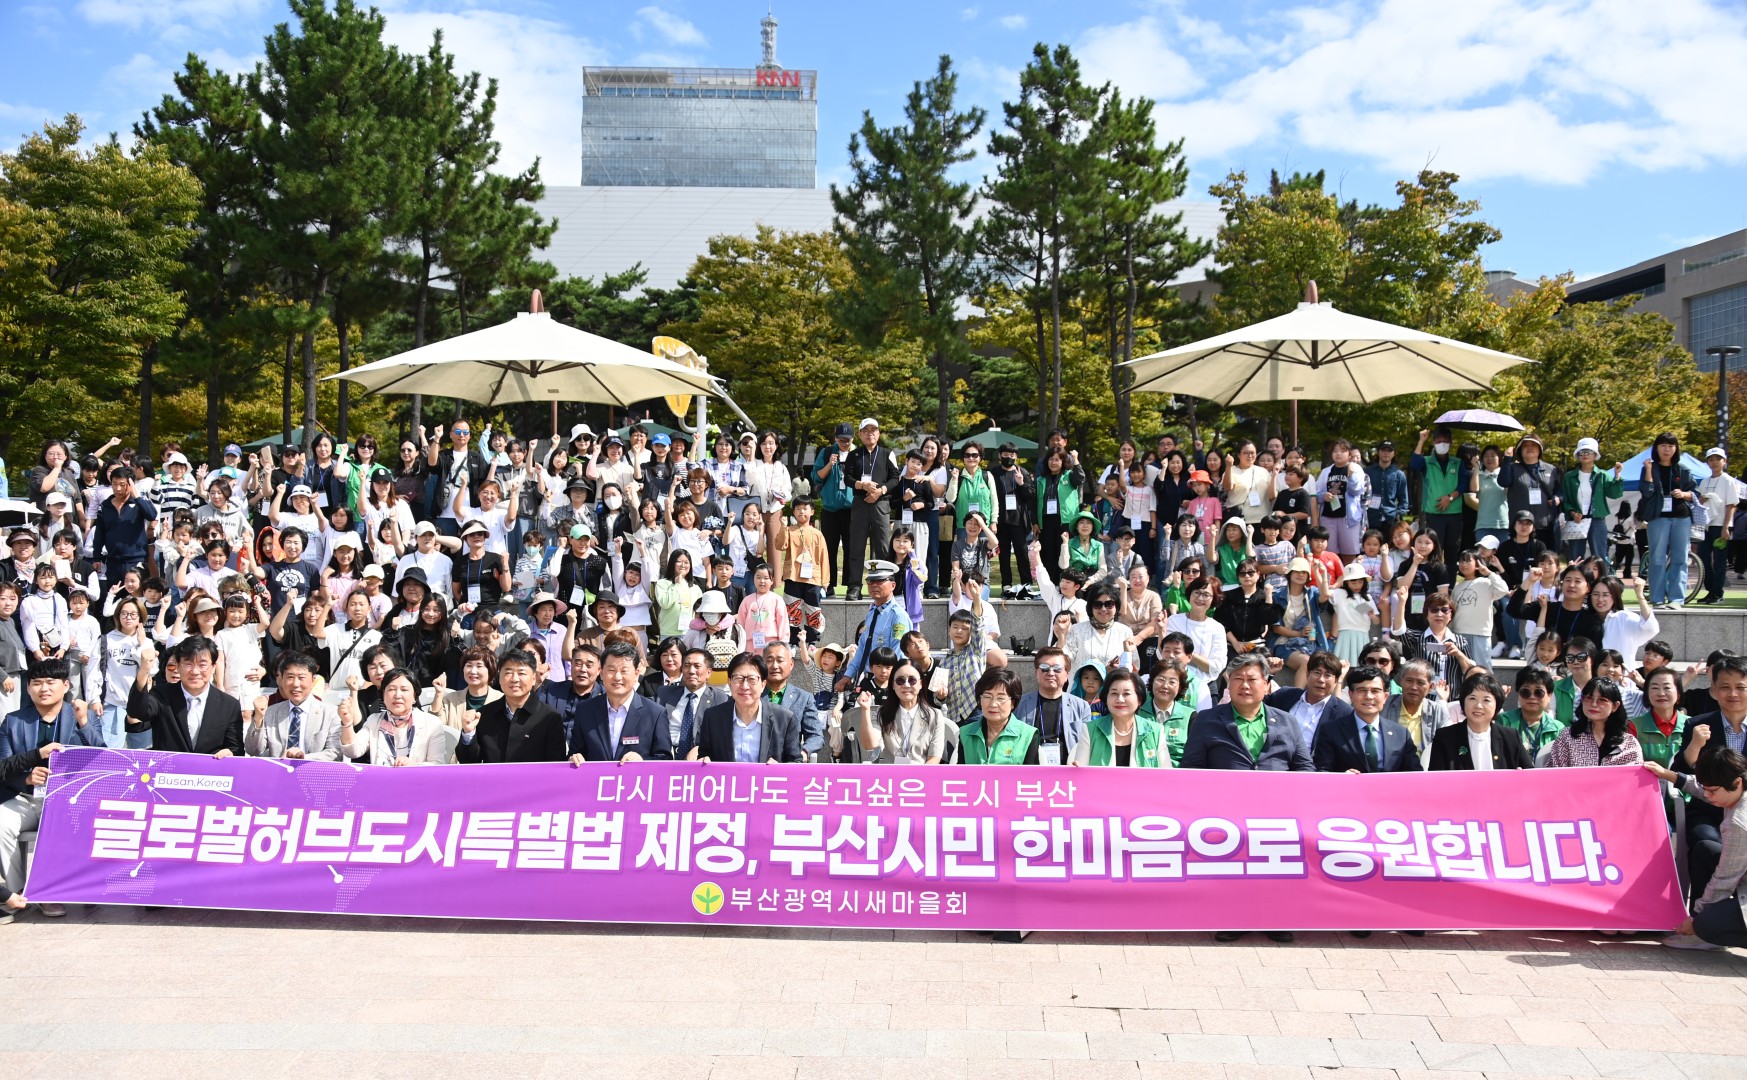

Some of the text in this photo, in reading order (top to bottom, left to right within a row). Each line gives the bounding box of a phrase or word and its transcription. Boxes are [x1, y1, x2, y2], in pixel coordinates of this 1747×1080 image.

[757, 69, 799, 87] KNN
[157, 775, 230, 789] Busan,Korea
[597, 774, 1077, 809] 다시 태어나도 살고싶은 도시 부산
[90, 800, 1620, 883] 글로벌허브도시특별법 제정, 부산시민 한마음으로 응원합니다.
[729, 887, 968, 915] 부산광역시새마을회
